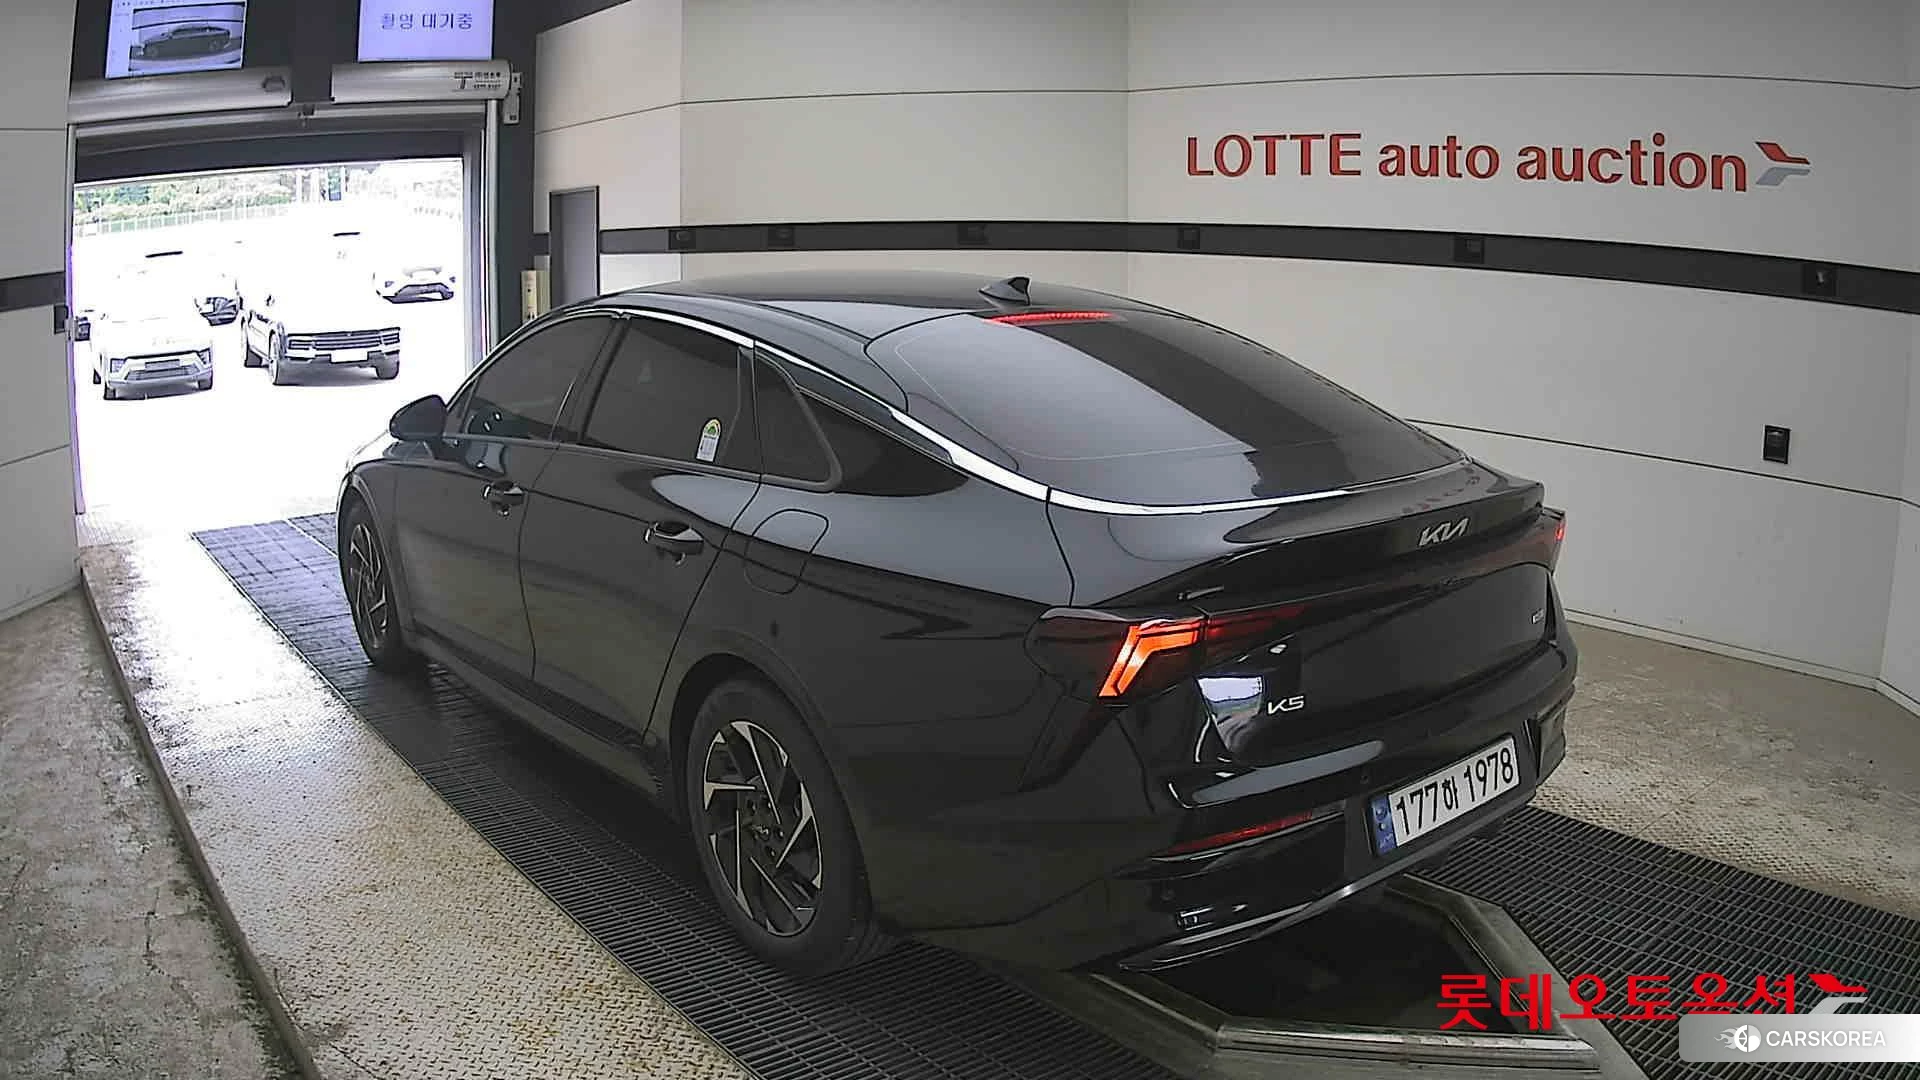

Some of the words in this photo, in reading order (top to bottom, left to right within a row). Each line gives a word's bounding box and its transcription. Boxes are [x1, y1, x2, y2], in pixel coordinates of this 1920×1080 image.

[421, 12, 473, 30] 대기중
[1186, 133, 1362, 177] LOTTE
[1377, 135, 1500, 180] auto
[1516, 132, 1748, 193] auction
[1418, 516, 1471, 547] KIA
[1267, 695, 1305, 715] K5
[1396, 778, 1460, 836] 177하
[1463, 747, 1514, 803] 1978
